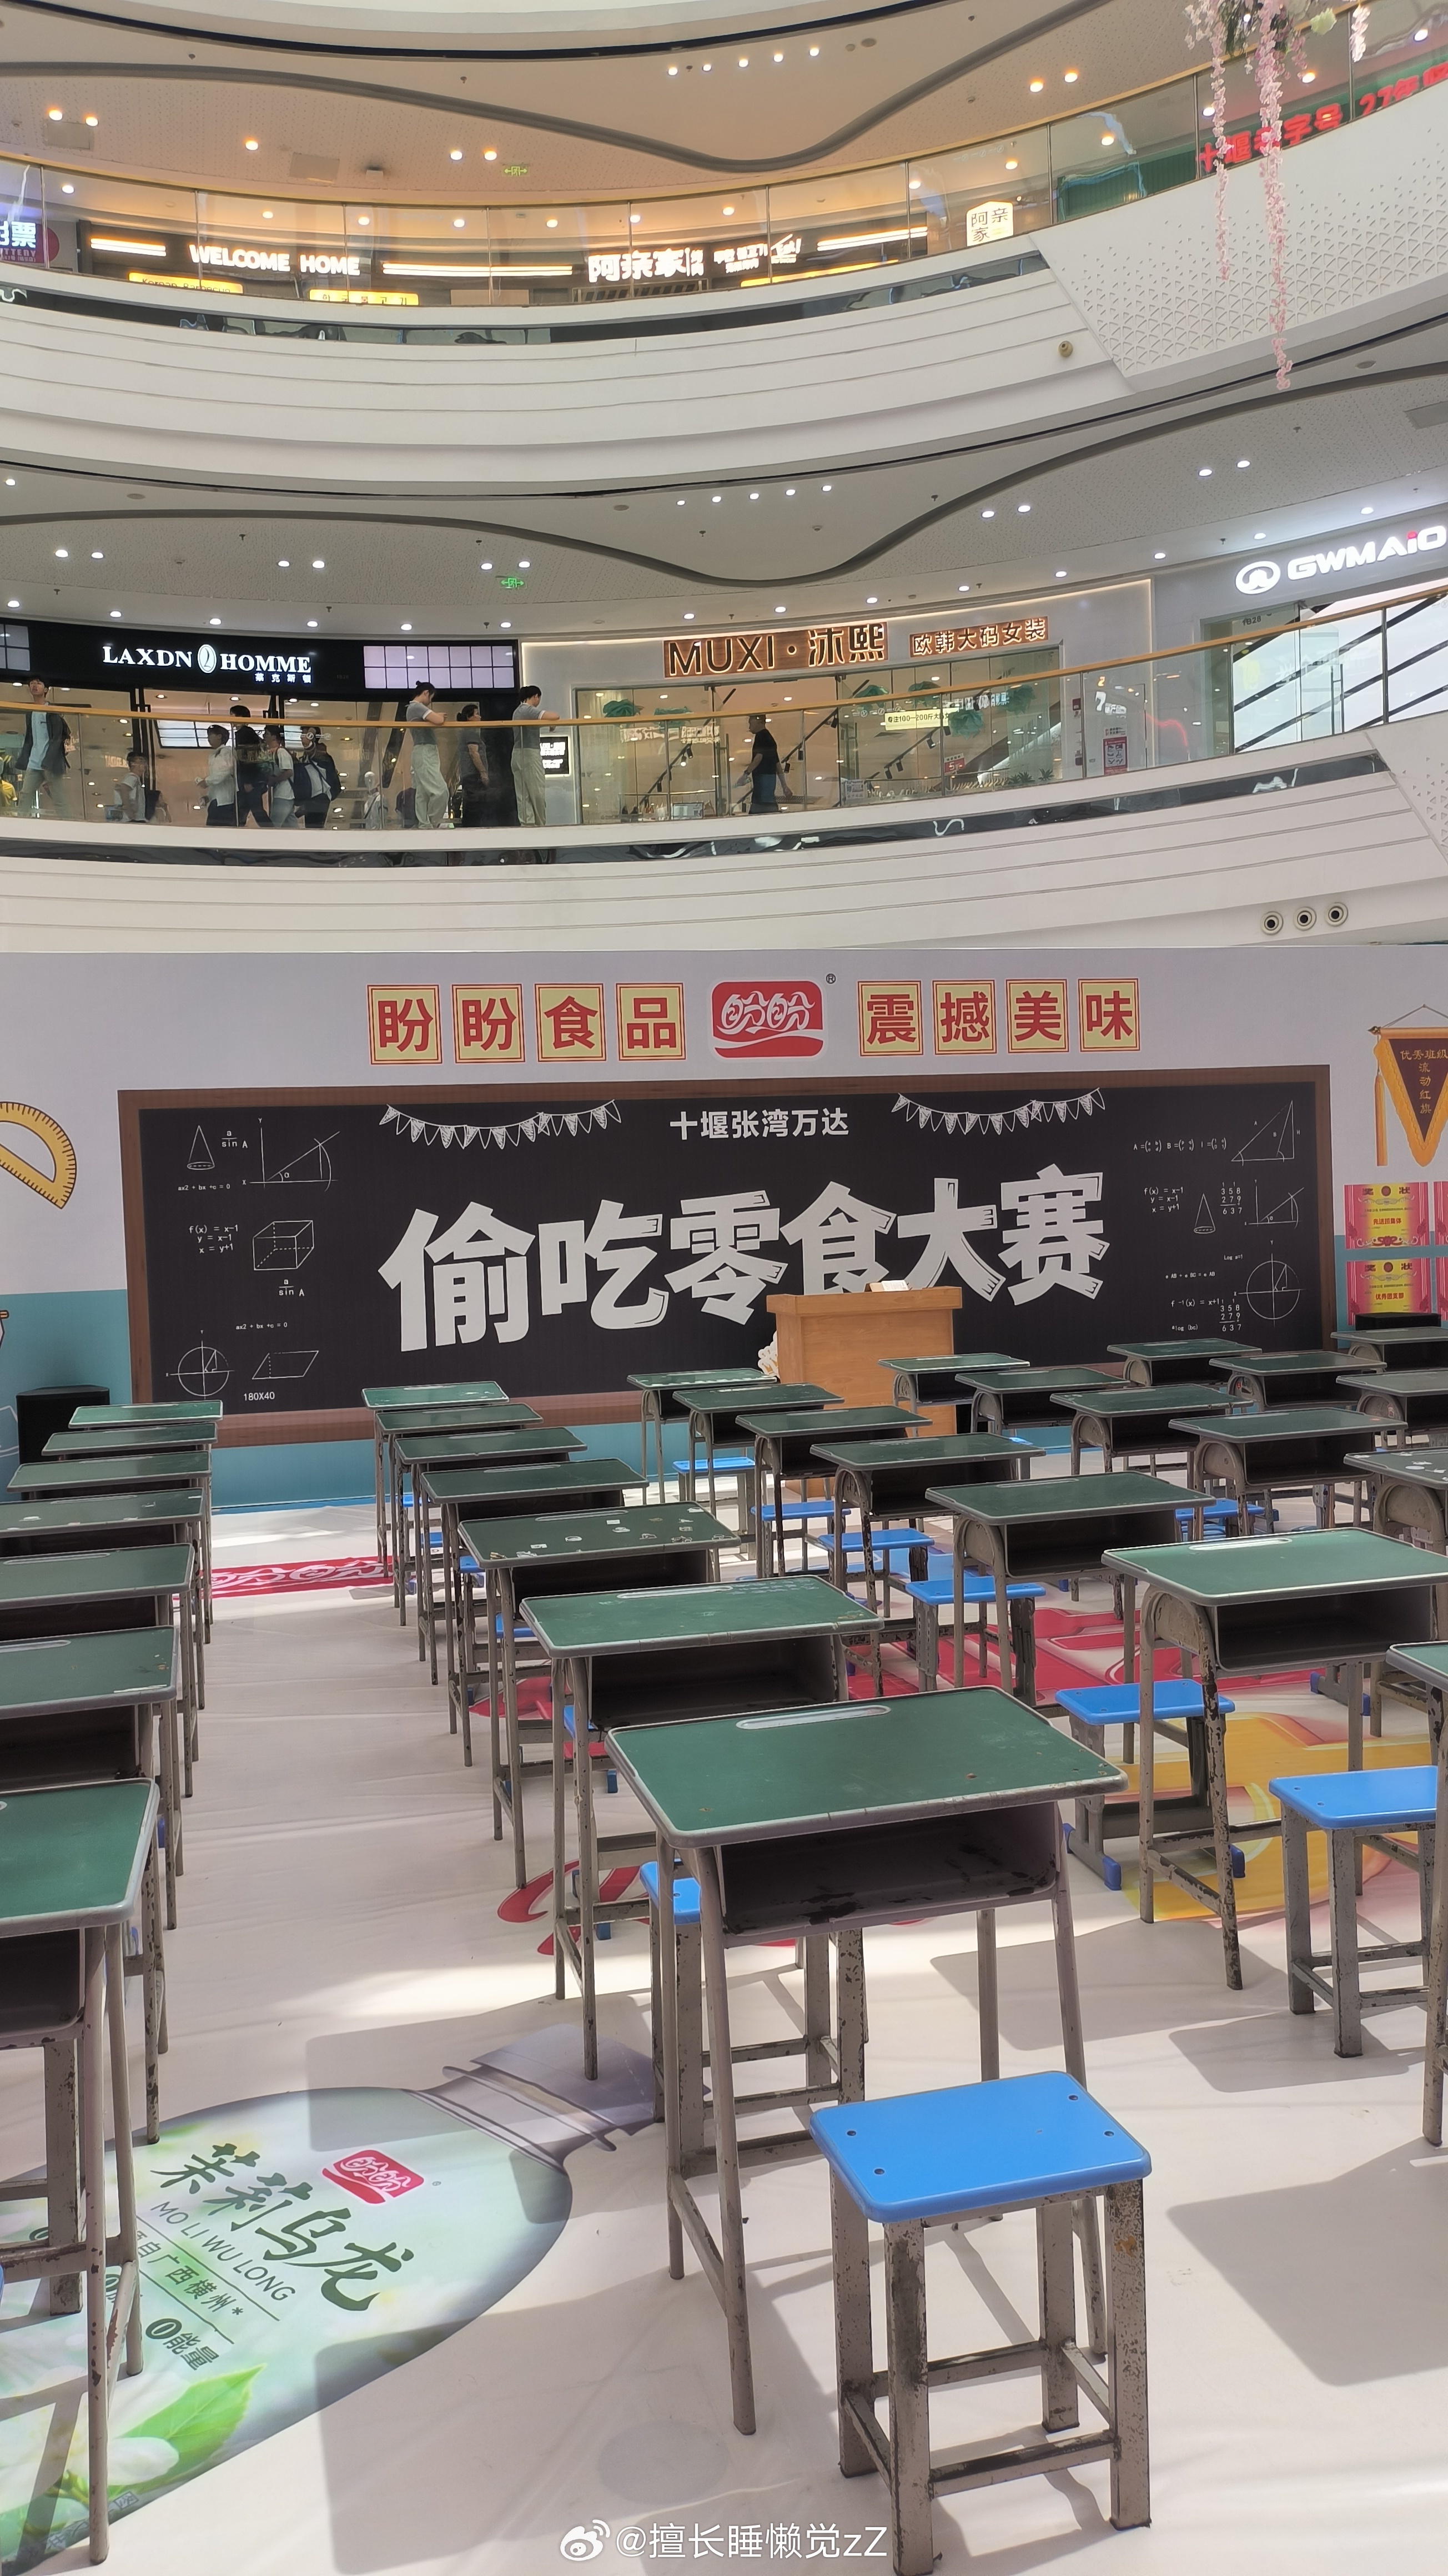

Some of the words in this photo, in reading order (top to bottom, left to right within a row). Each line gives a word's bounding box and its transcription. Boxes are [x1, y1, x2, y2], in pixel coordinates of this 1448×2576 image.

[189, 245, 290, 272] WELCOME
[300, 255, 360, 276] HOME
[913, 617, 1045, 656] 欧韩大码女装
[1242, 615, 1261, 626] 1B28
[103, 646, 192, 668] LAXDN
[220, 653, 311, 673] HOMME
[669, 635, 775, 676] MUXI
[808, 623, 884, 667] 沐熙
[378, 995, 677, 1052] 盼盼食品
[865, 990, 1134, 1045] 震撼美味
[1400, 1049, 1448, 1061] 优秀班级
[670, 1108, 849, 1140] 十堰张湾万达
[222, 1139, 238, 1148] sin
[242, 1140, 248, 1149] A
[378, 1164, 1110, 1352] 偷吃零食大赛
[279, 1287, 294, 1296] sin
[299, 1289, 305, 1297] A
[244, 1391, 275, 1401] 180X40
[150, 2143, 414, 2312] 茉莉乌龙
[150, 2201, 189, 2224] MO
[180, 2222, 210, 2239] LI
[202, 2235, 244, 2261] WU
[232, 2259, 296, 2302] LONG
[145, 2318, 219, 2371] 0能量
